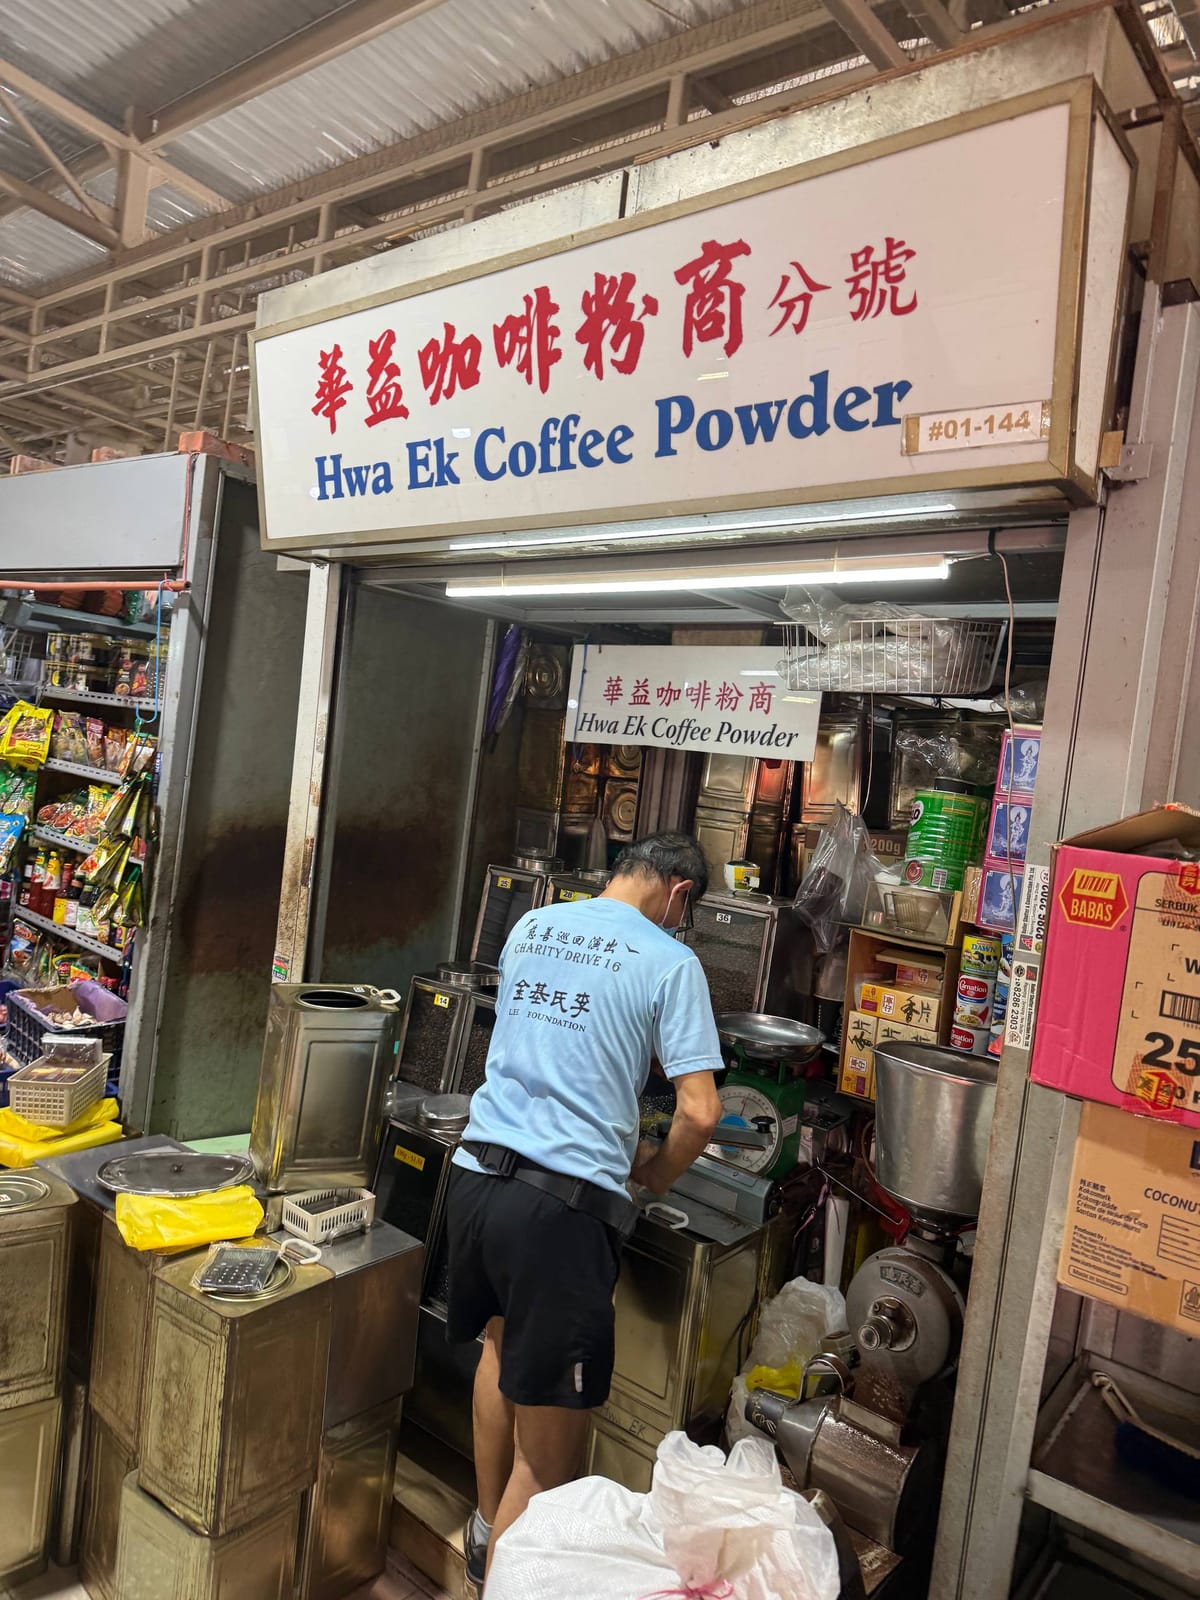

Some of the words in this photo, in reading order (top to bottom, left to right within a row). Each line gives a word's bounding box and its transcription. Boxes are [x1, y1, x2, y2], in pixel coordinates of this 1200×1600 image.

[316, 455, 392, 500] Hwa
[407, 438, 460, 490] Ek
[474, 415, 633, 481] Coffee
[656, 371, 914, 457] Powder
[928, 411, 1031, 441] #01-144
[603, 675, 776, 715] 華益咖啡粉商
[578, 712, 619, 735] Hwa
[622, 716, 646, 737] Ek
[651, 718, 711, 746] Coffee
[715, 722, 799, 749] Powder
[1155, 898, 1199, 913] SERBUK
[717, 914, 729, 922] 36
[514, 942, 565, 959] CHARITY
[564, 950, 602, 967] DRIVE
[604, 958, 622, 973] 16
[960, 979, 987, 993] Carnation
[438, 997, 448, 1007] 14
[1012, 987, 1021, 1008] 8286
[527, 1011, 587, 1032] FOUNDATION
[1010, 1009, 1019, 1030] 2303
[629, 1418, 647, 1438] EK
